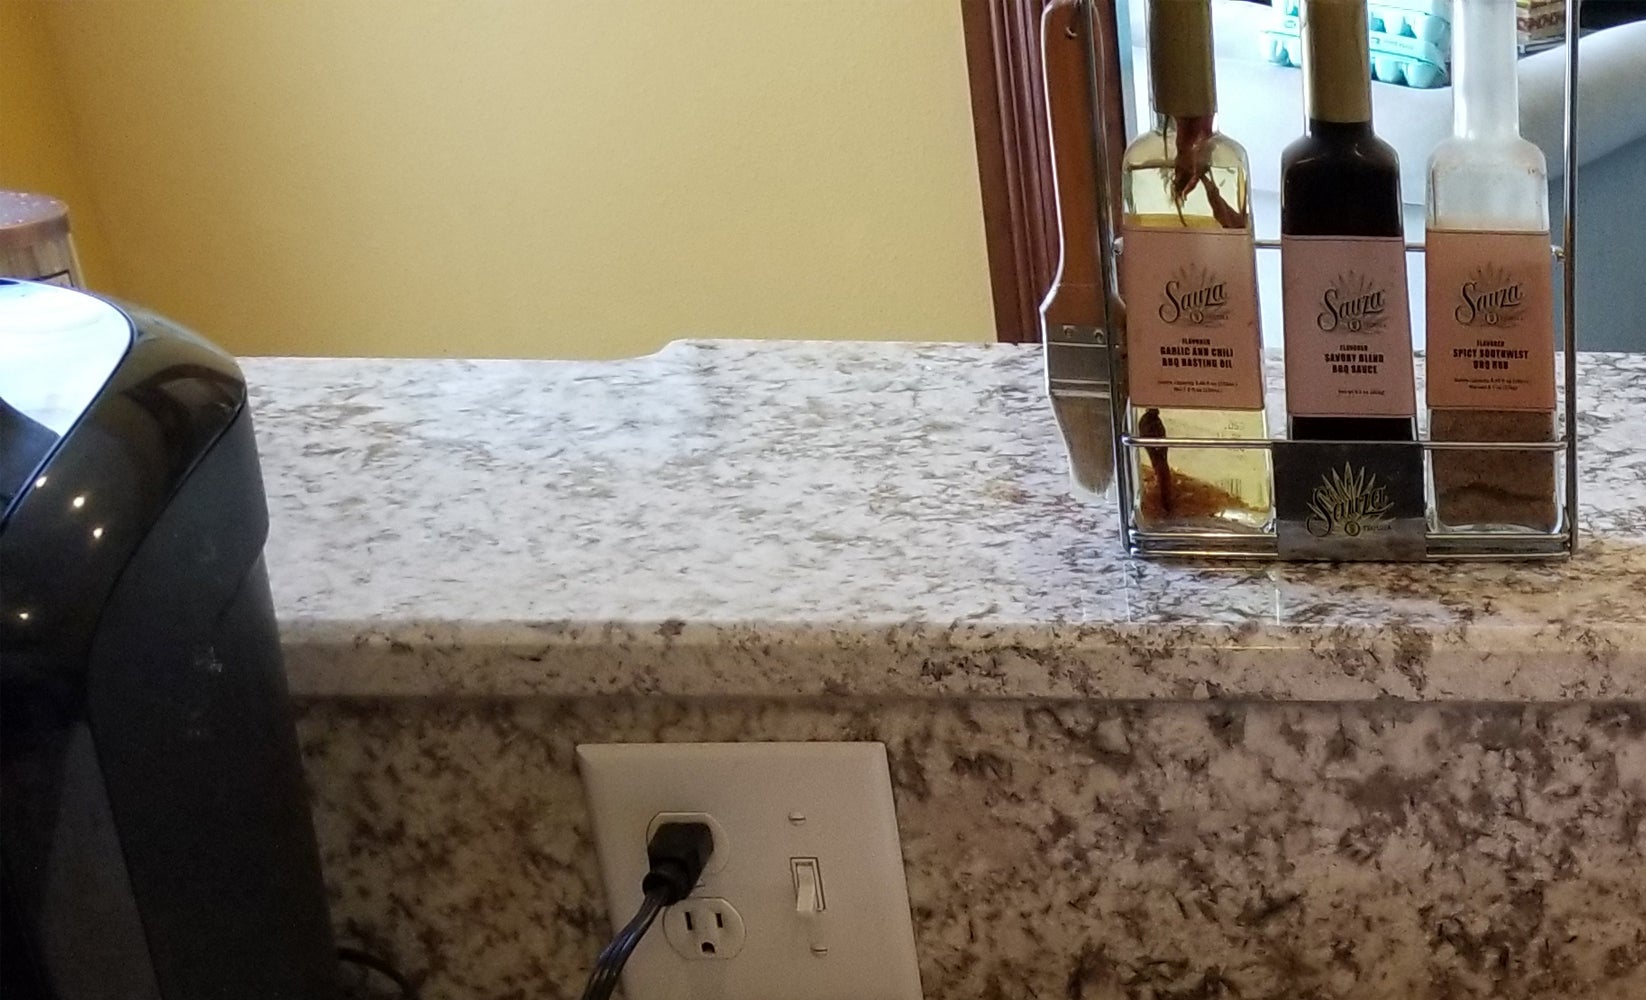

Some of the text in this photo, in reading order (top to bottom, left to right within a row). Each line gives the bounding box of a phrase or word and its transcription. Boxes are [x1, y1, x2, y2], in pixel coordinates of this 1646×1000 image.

[1158, 281, 1228, 324] Sauza
[1455, 281, 1522, 325] Sauza
[1317, 288, 1385, 332] Sauza
[1160, 346, 1190, 356] GARLIC
[1192, 347, 1209, 357] AND
[1453, 348, 1529, 359] SPICY SOUTHWEST
[1182, 358, 1217, 368] BASTING
[1220, 359, 1233, 369] OIL
[1324, 353, 1357, 363] SAVORY
[1351, 364, 1378, 374] SAUCE
[1306, 486, 1391, 537] Sauza
